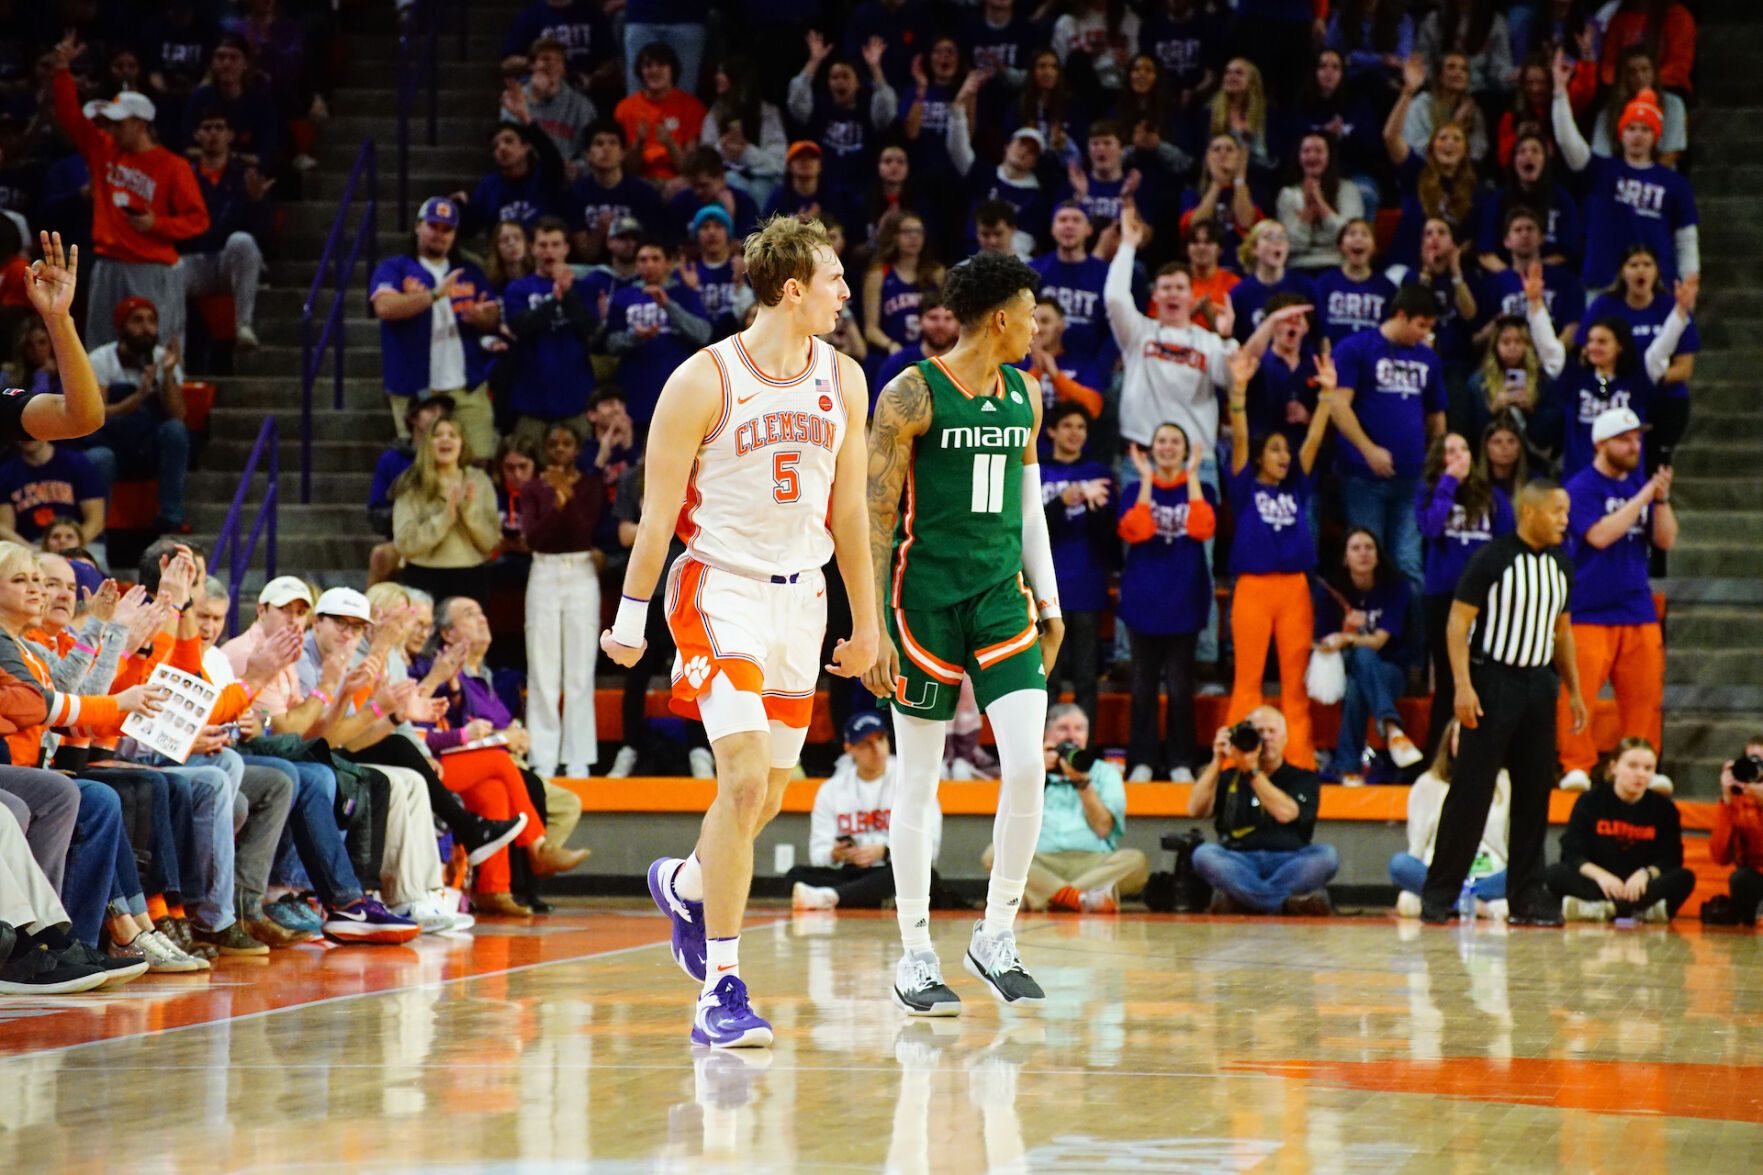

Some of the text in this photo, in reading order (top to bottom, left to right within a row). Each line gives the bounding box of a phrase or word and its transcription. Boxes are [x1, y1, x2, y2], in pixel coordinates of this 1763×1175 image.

[1327, 290, 1386, 320] GRIT
[1376, 357, 1430, 390] GRIT
[735, 411, 837, 457] CLEMSON
[773, 451, 802, 504] 5
[971, 453, 1007, 513] 11
[837, 810, 891, 834] CLEMSO
